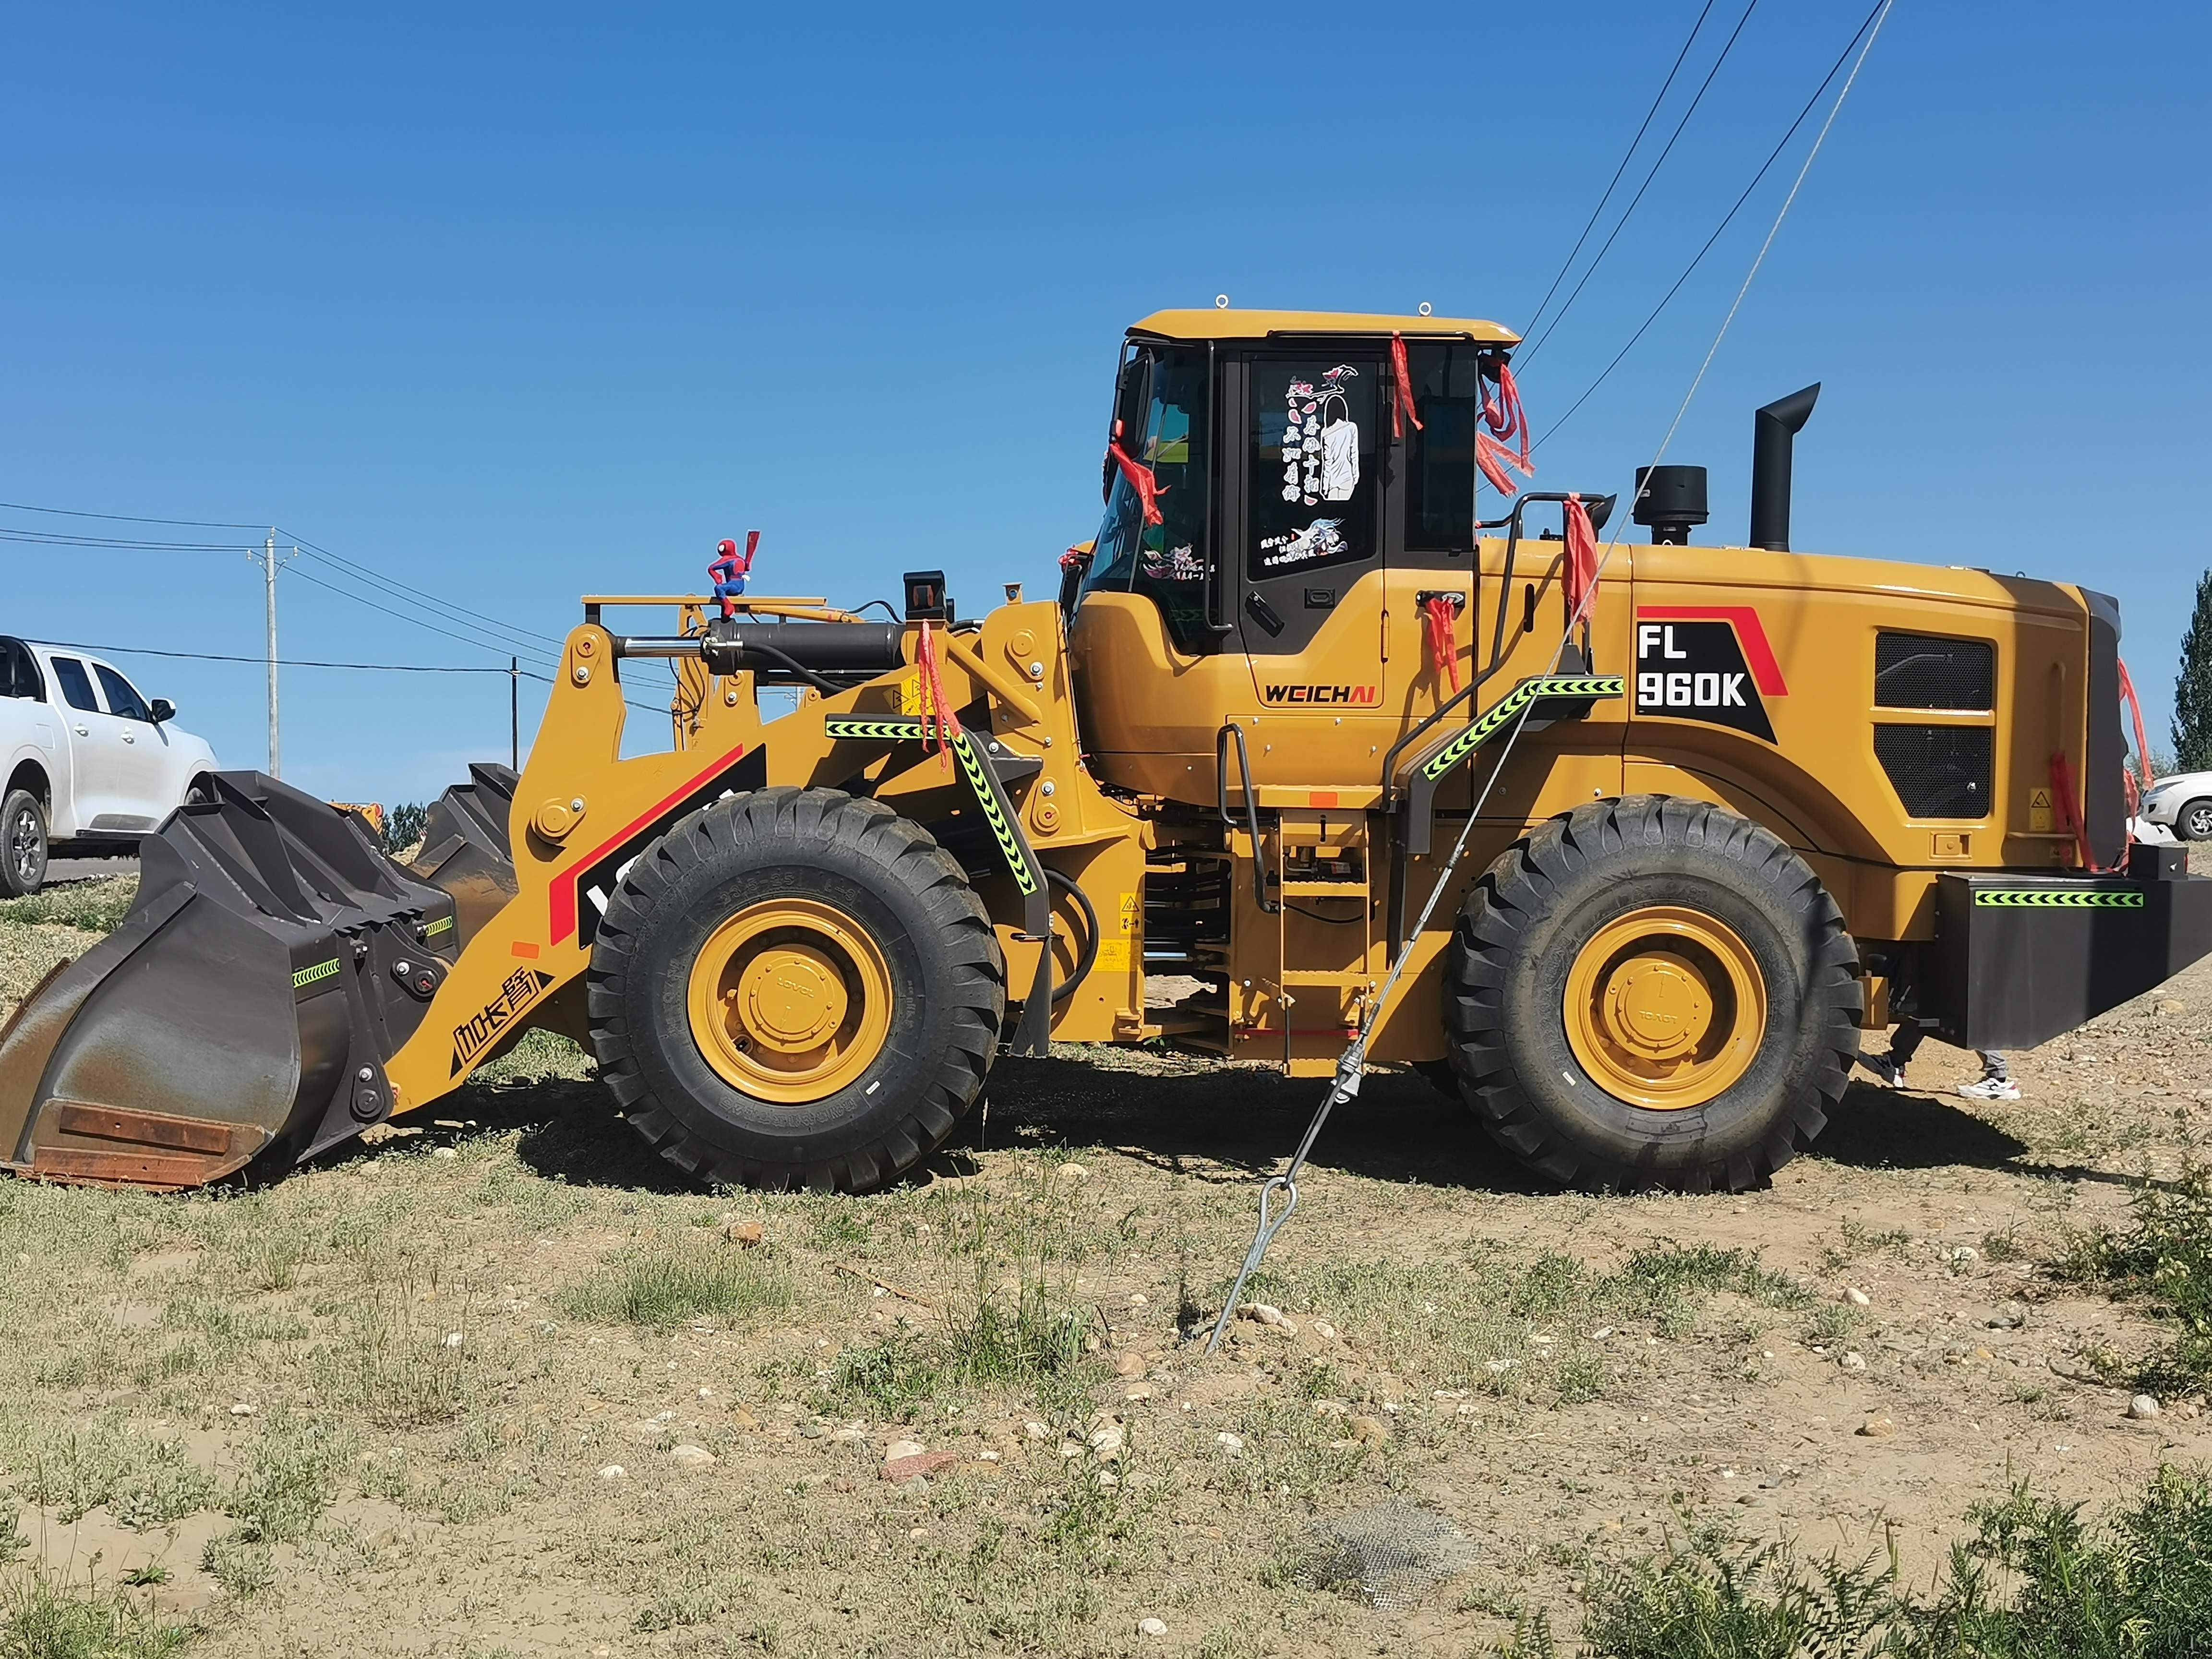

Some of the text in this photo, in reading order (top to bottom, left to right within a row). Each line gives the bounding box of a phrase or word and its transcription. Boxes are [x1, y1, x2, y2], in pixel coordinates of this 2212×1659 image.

[1638, 625, 1686, 659] FL
[1265, 685, 1376, 703] WEICHAI
[1638, 673, 1746, 707] 960K
